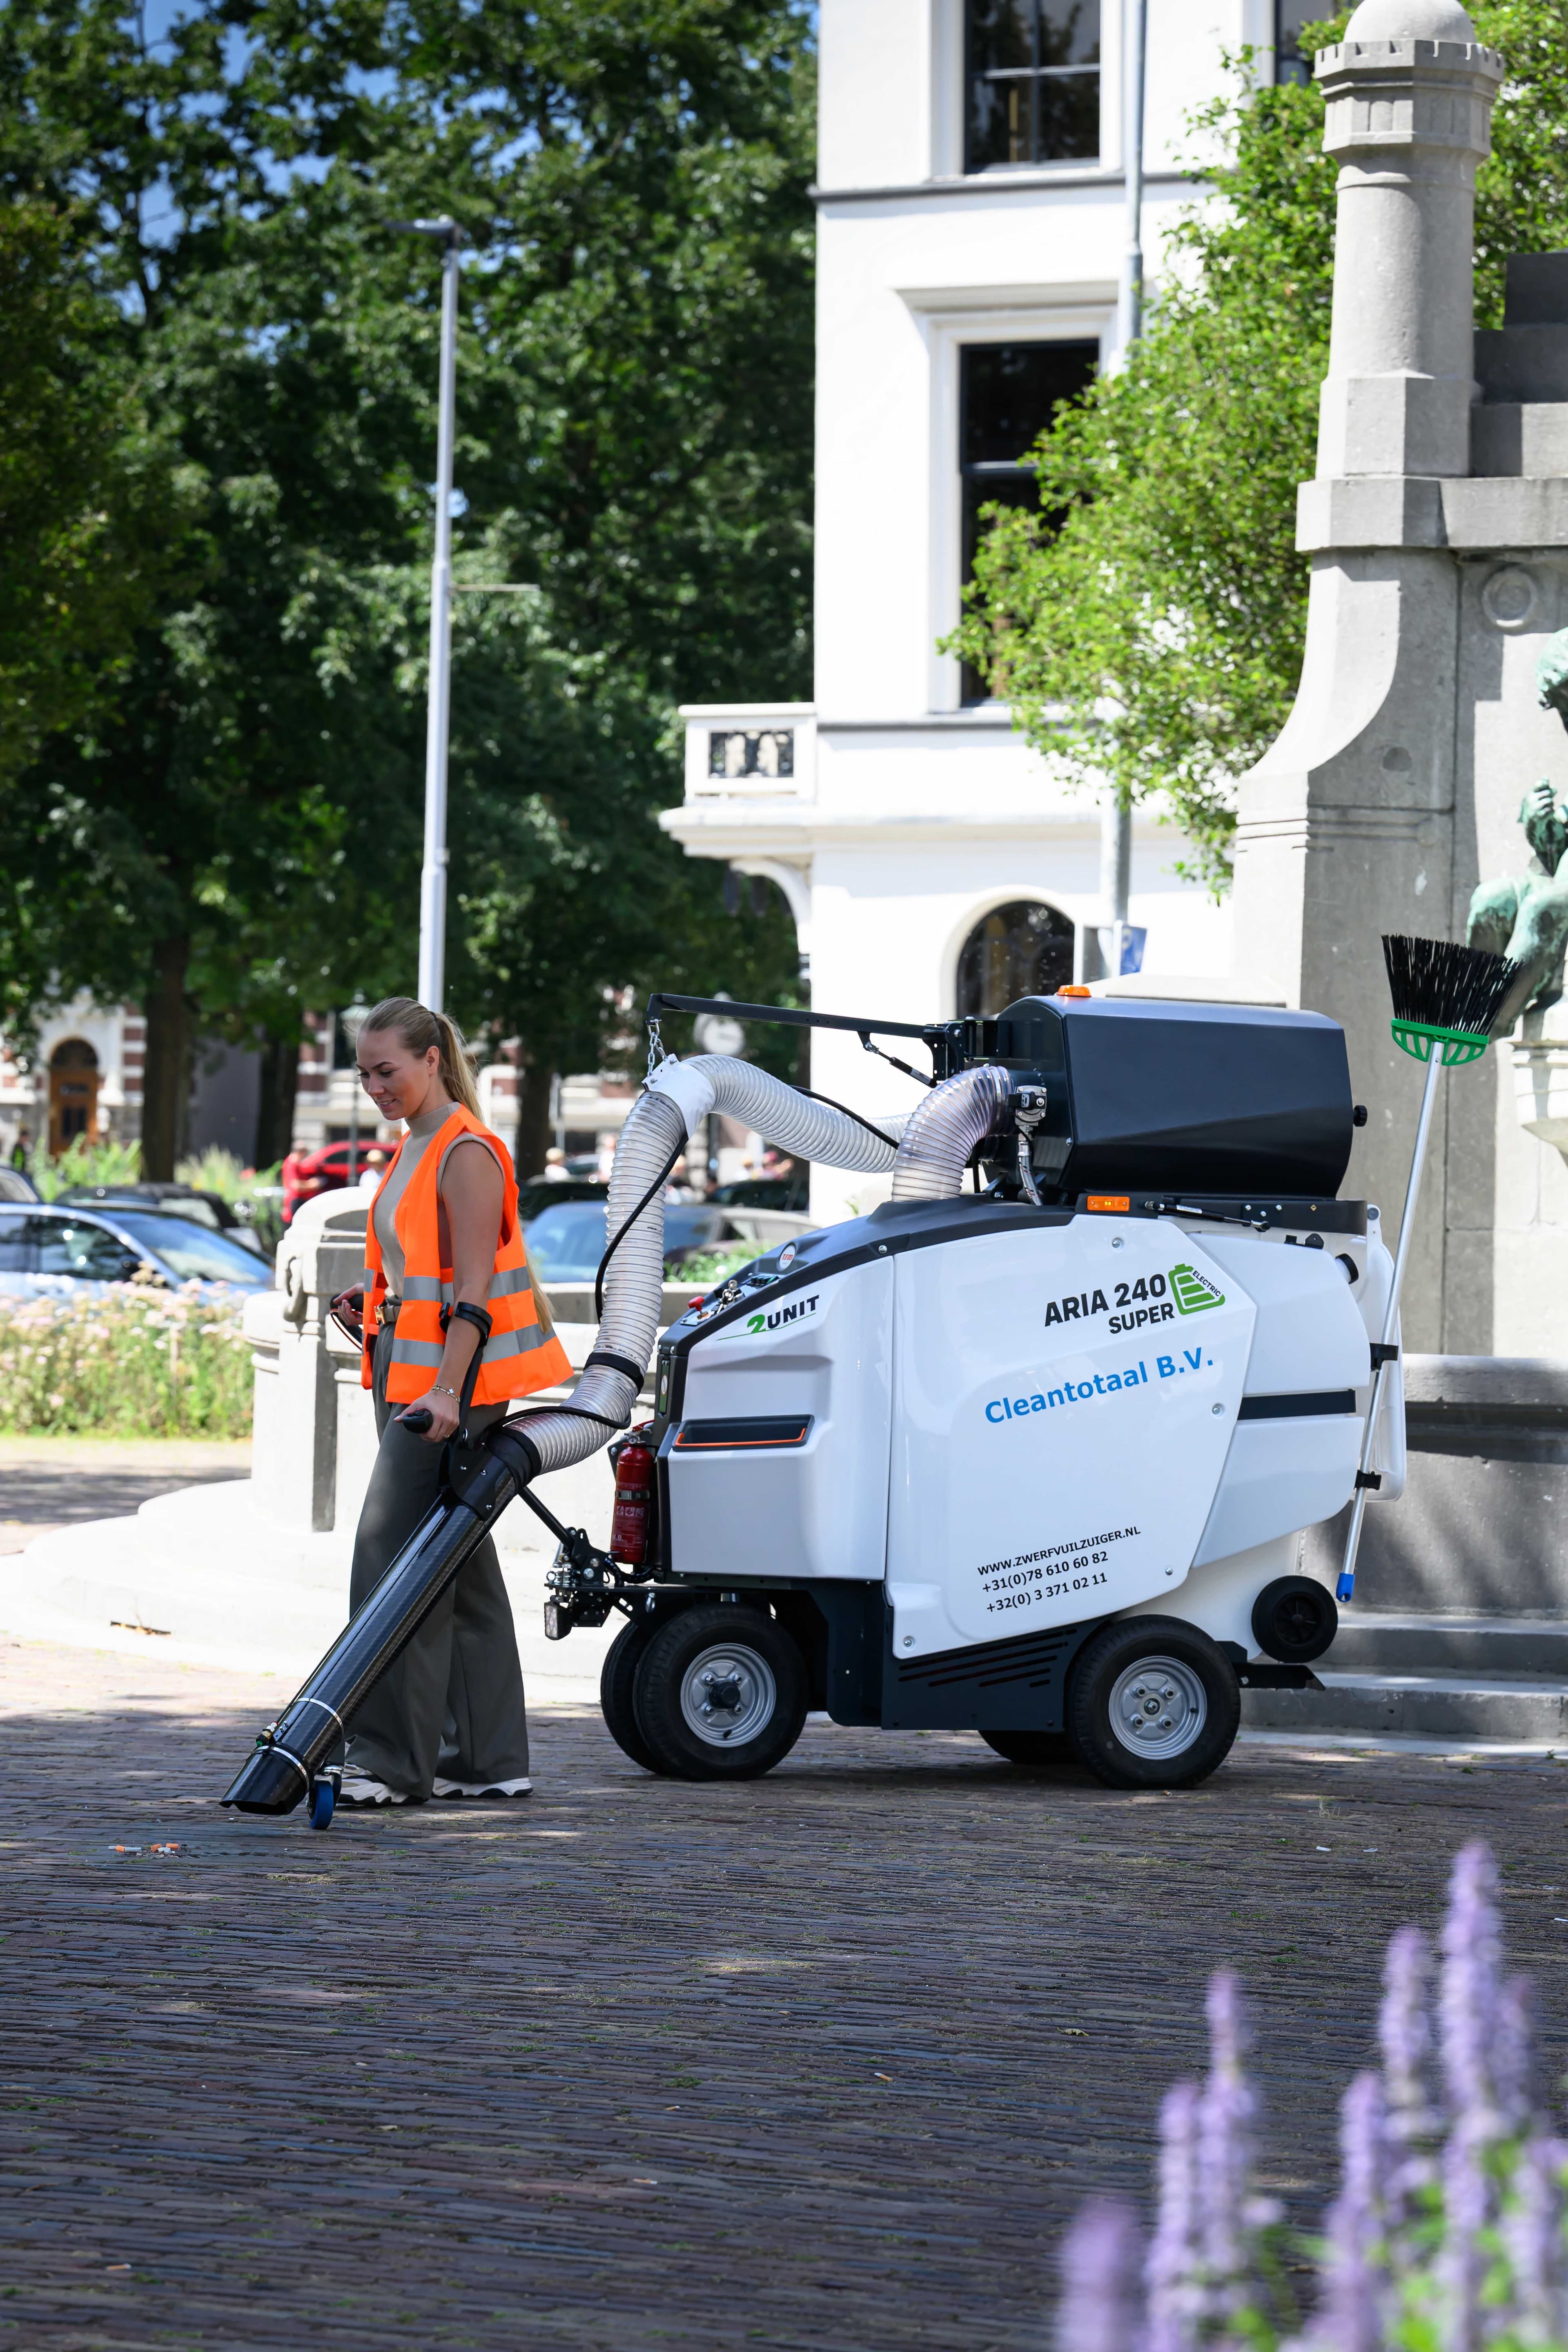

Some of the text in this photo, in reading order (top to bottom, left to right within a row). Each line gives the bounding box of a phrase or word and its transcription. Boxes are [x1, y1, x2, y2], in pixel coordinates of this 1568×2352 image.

[1045, 1274, 1166, 1327] ARIA 240
[1193, 1270, 1221, 1296] ELECTRIC
[747, 1294, 820, 1333] 2UNIT
[1109, 1303, 1175, 1334] SUPER
[985, 1347, 1213, 1423] Cleantotaal B.V.
[977, 1526, 1141, 1575] WWW.ZWERFVUILZUIGER.NL
[982, 1551, 1108, 1592] +31(0)78 610 60 82
[987, 1572, 1107, 1612] +32(0) 3 371 02 11
